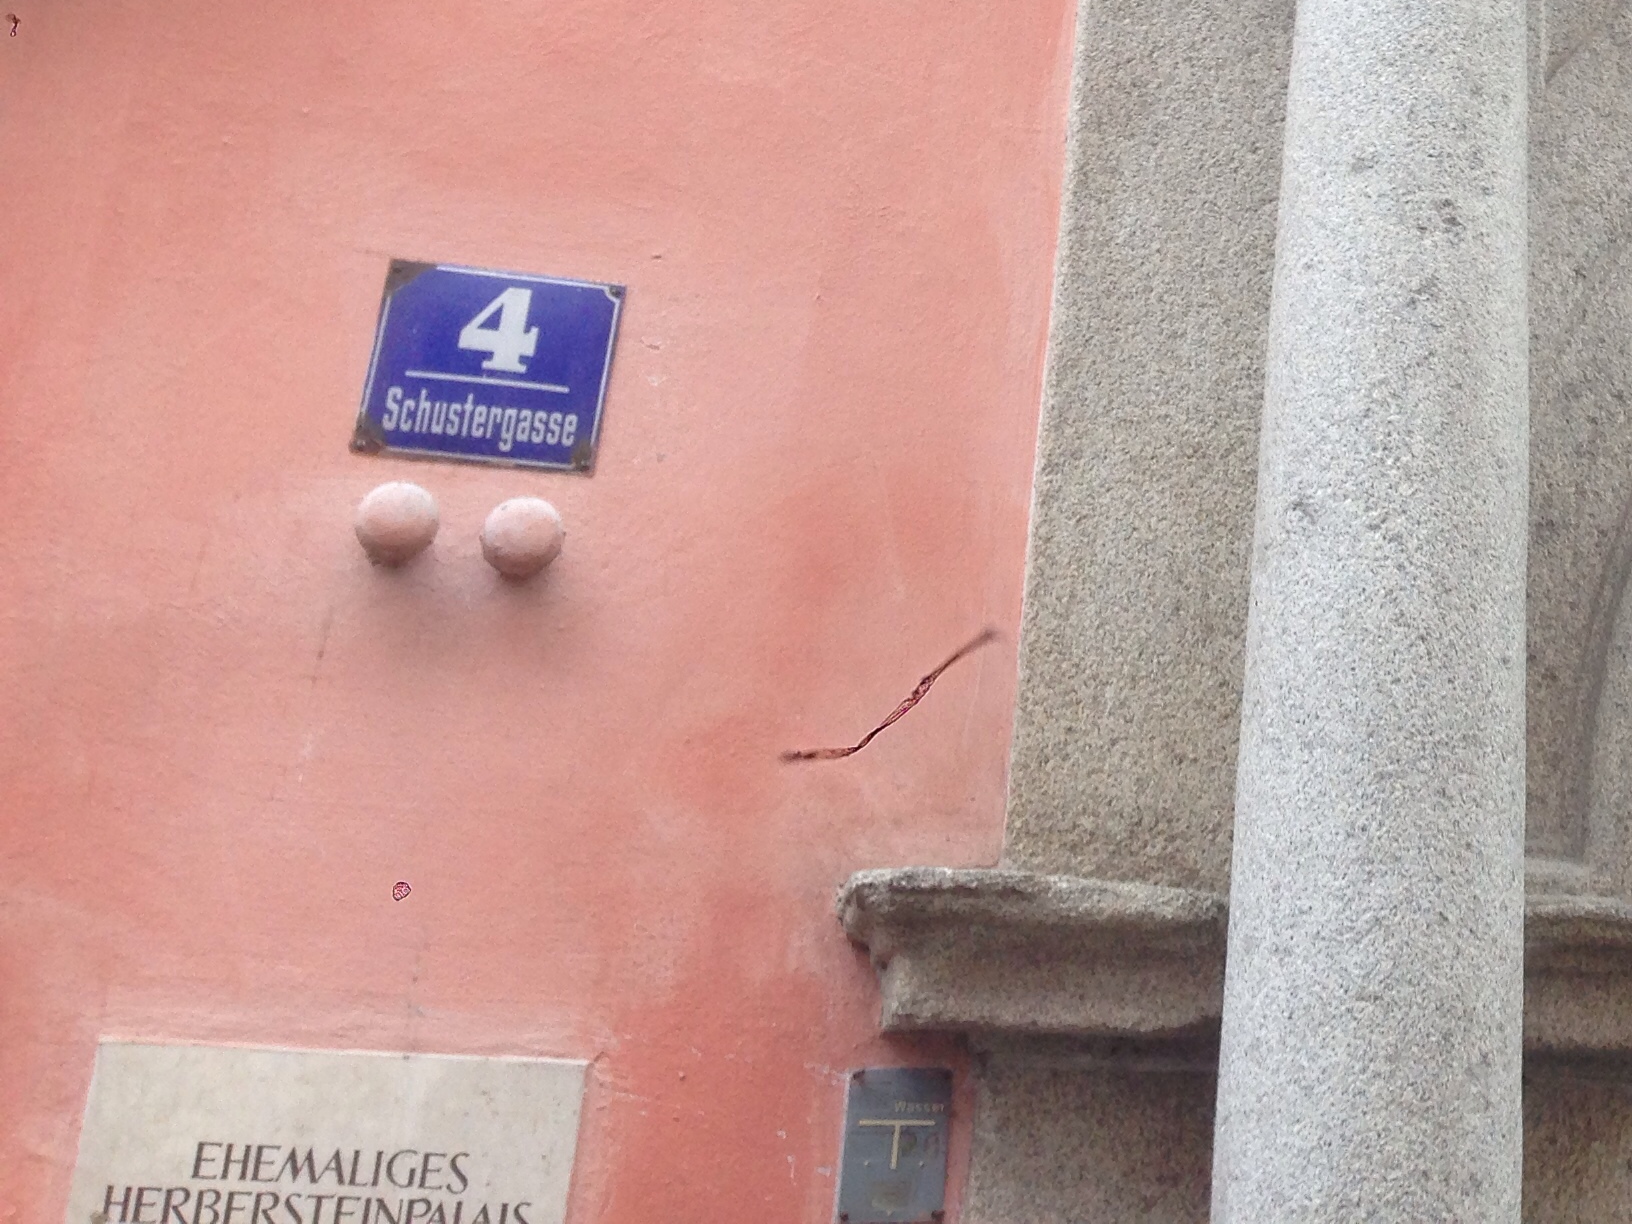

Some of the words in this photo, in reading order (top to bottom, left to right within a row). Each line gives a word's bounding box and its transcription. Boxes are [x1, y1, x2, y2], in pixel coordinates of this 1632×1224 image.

[458, 287, 539, 375] 4
[382, 385, 579, 452] Schustergasse
[894, 1099, 945, 1114] Wasser
[191, 1141, 469, 1195] EHEMALIGES
